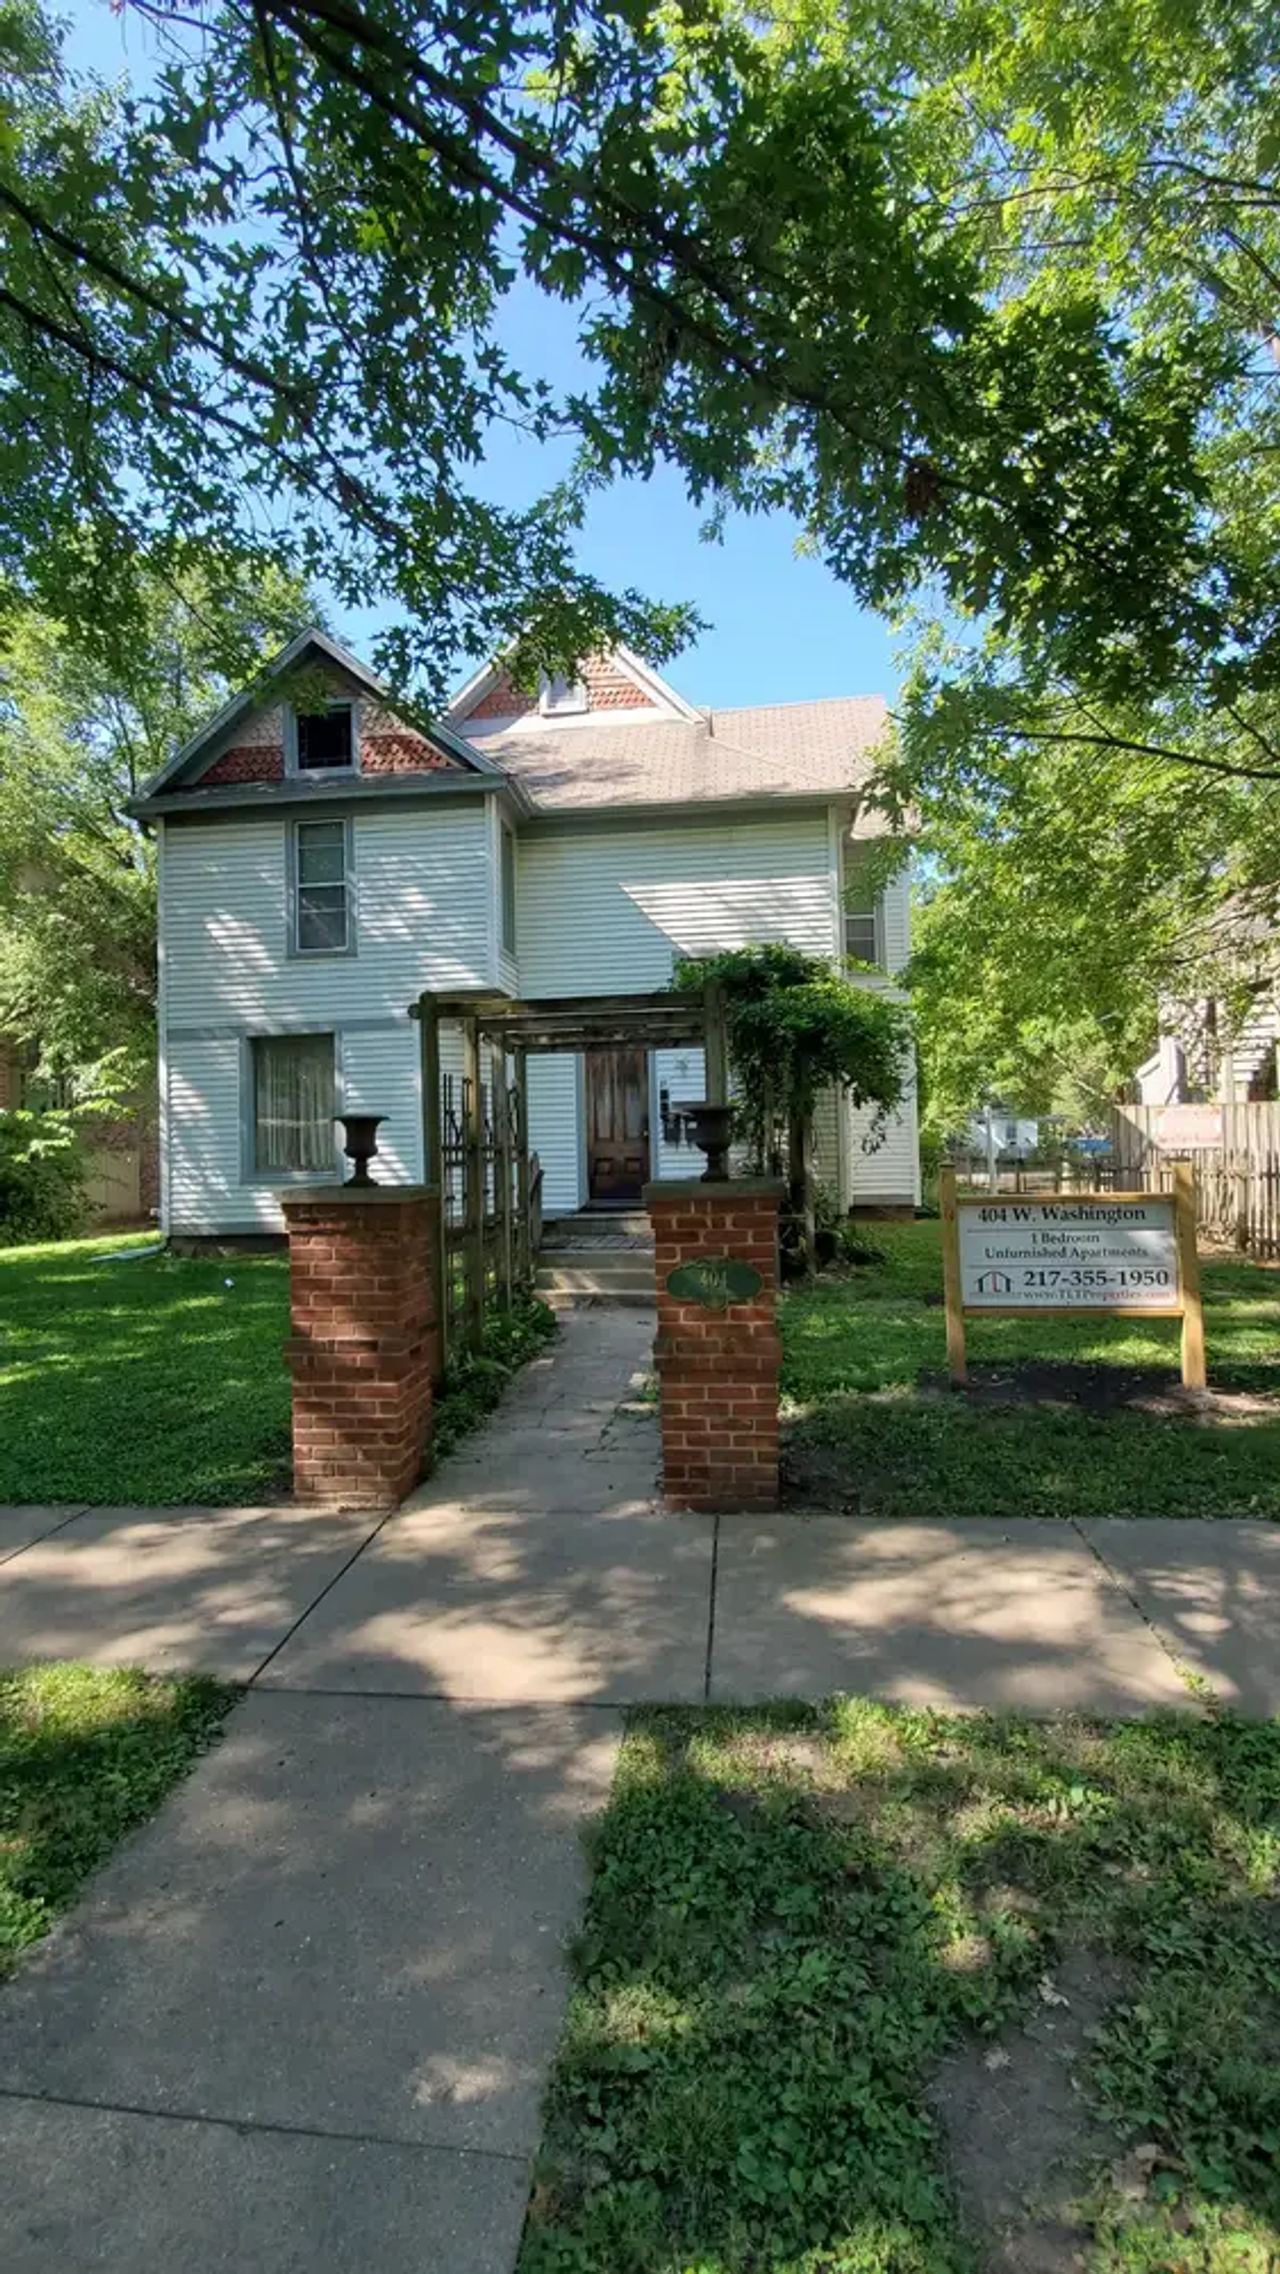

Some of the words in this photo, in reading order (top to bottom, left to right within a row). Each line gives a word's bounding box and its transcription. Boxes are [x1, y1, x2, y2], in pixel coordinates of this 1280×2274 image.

[978, 1207, 1007, 1222] 404
[1012, 1207, 1036, 1222] W.
[1041, 1205, 1146, 1225] Washington
[1041, 1232, 1100, 1244] Bedroom
[984, 1247, 1067, 1259] Unfurnished
[1071, 1247, 1149, 1261] Apartments
[1023, 1269, 1169, 1287] 217-355-1950
